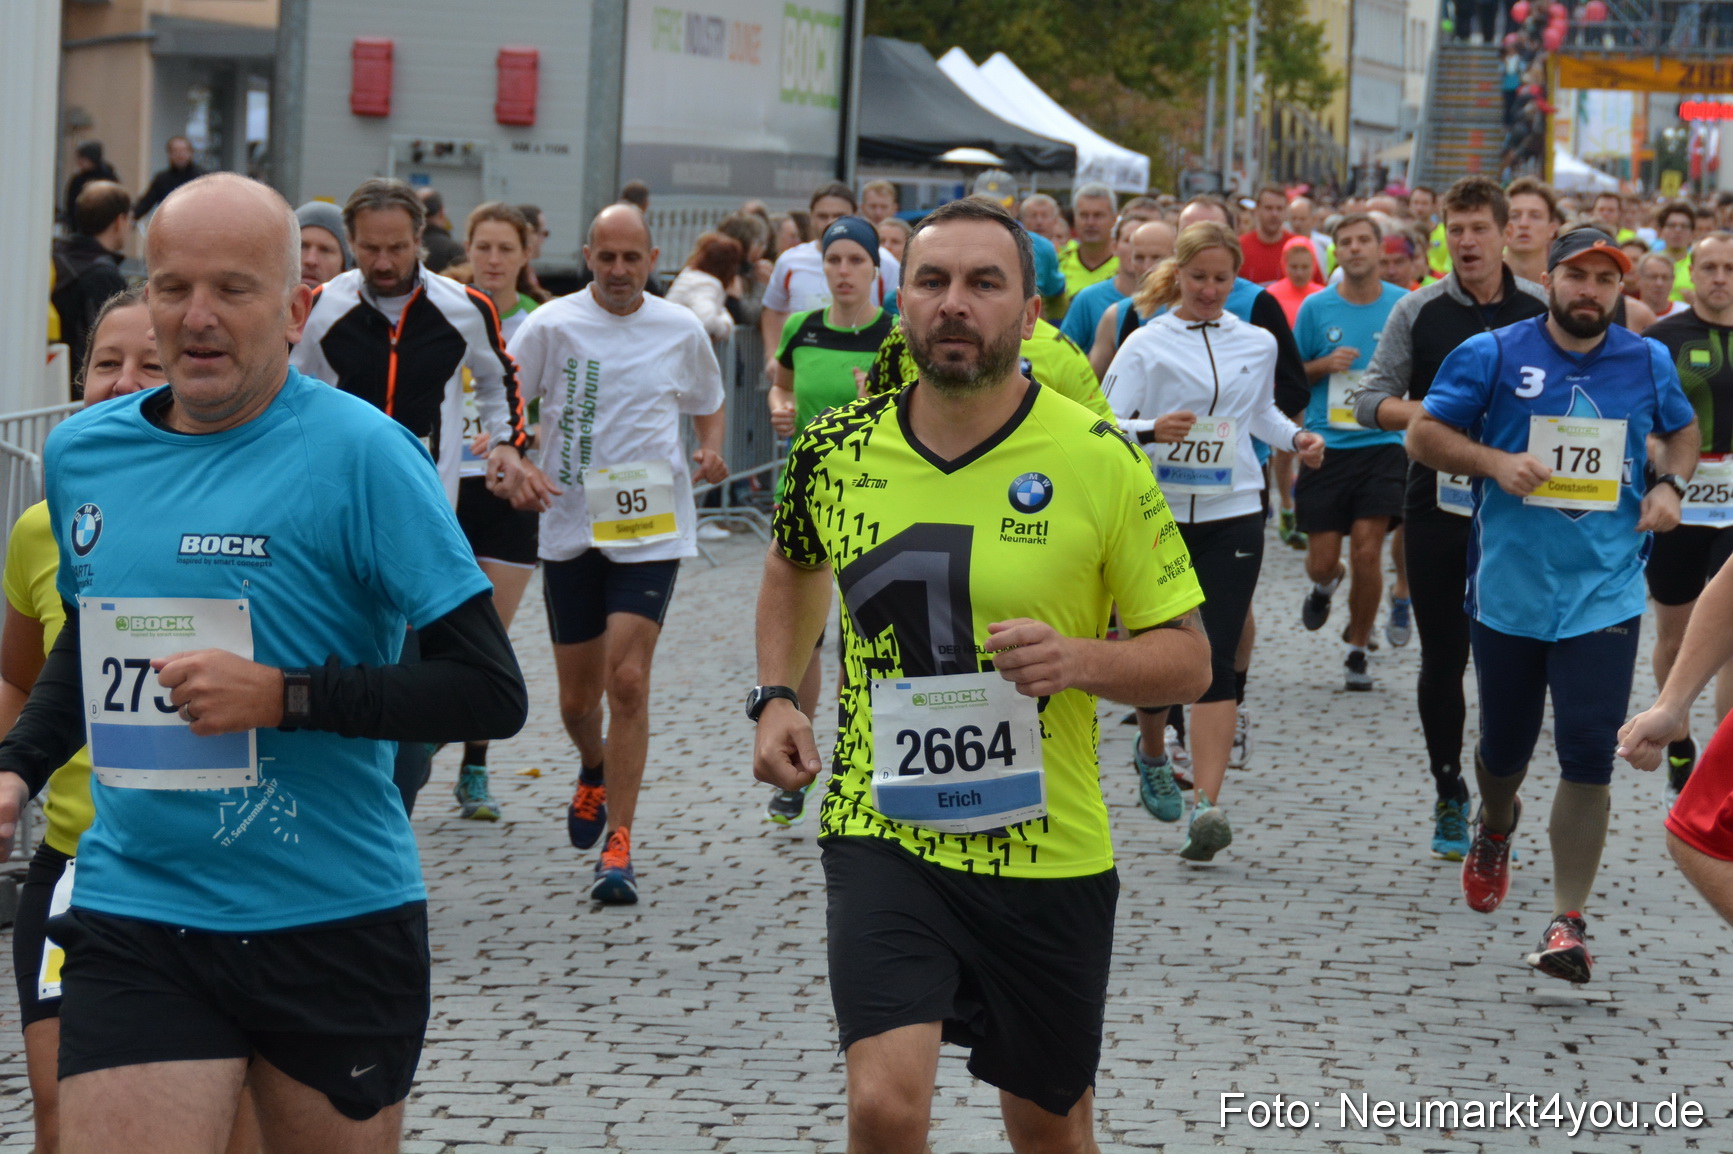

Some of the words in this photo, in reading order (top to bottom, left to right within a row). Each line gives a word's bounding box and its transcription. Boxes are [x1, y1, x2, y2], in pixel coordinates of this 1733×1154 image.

[1679, 63, 1733, 88] ZIE
[1515, 365, 1546, 398] 3
[1166, 440, 1224, 463] 2767
[1552, 445, 1602, 474] 178
[1548, 481, 1599, 493] Constantin
[1688, 484, 1733, 503] 225
[616, 488, 647, 515] 95
[1001, 517, 1049, 536] Partl
[179, 534, 269, 557] BOCK
[1000, 534, 1047, 545] Neumarkt
[176, 557, 202, 566] inspired
[203, 558, 212, 566] by
[213, 559, 235, 567] smart
[237, 559, 273, 568] concepts
[131, 616, 195, 631] BOCK
[929, 689, 988, 705] BOCK
[895, 720, 1016, 776] 2664
[938, 790, 982, 808] Erich
[231, 797, 269, 838] September
